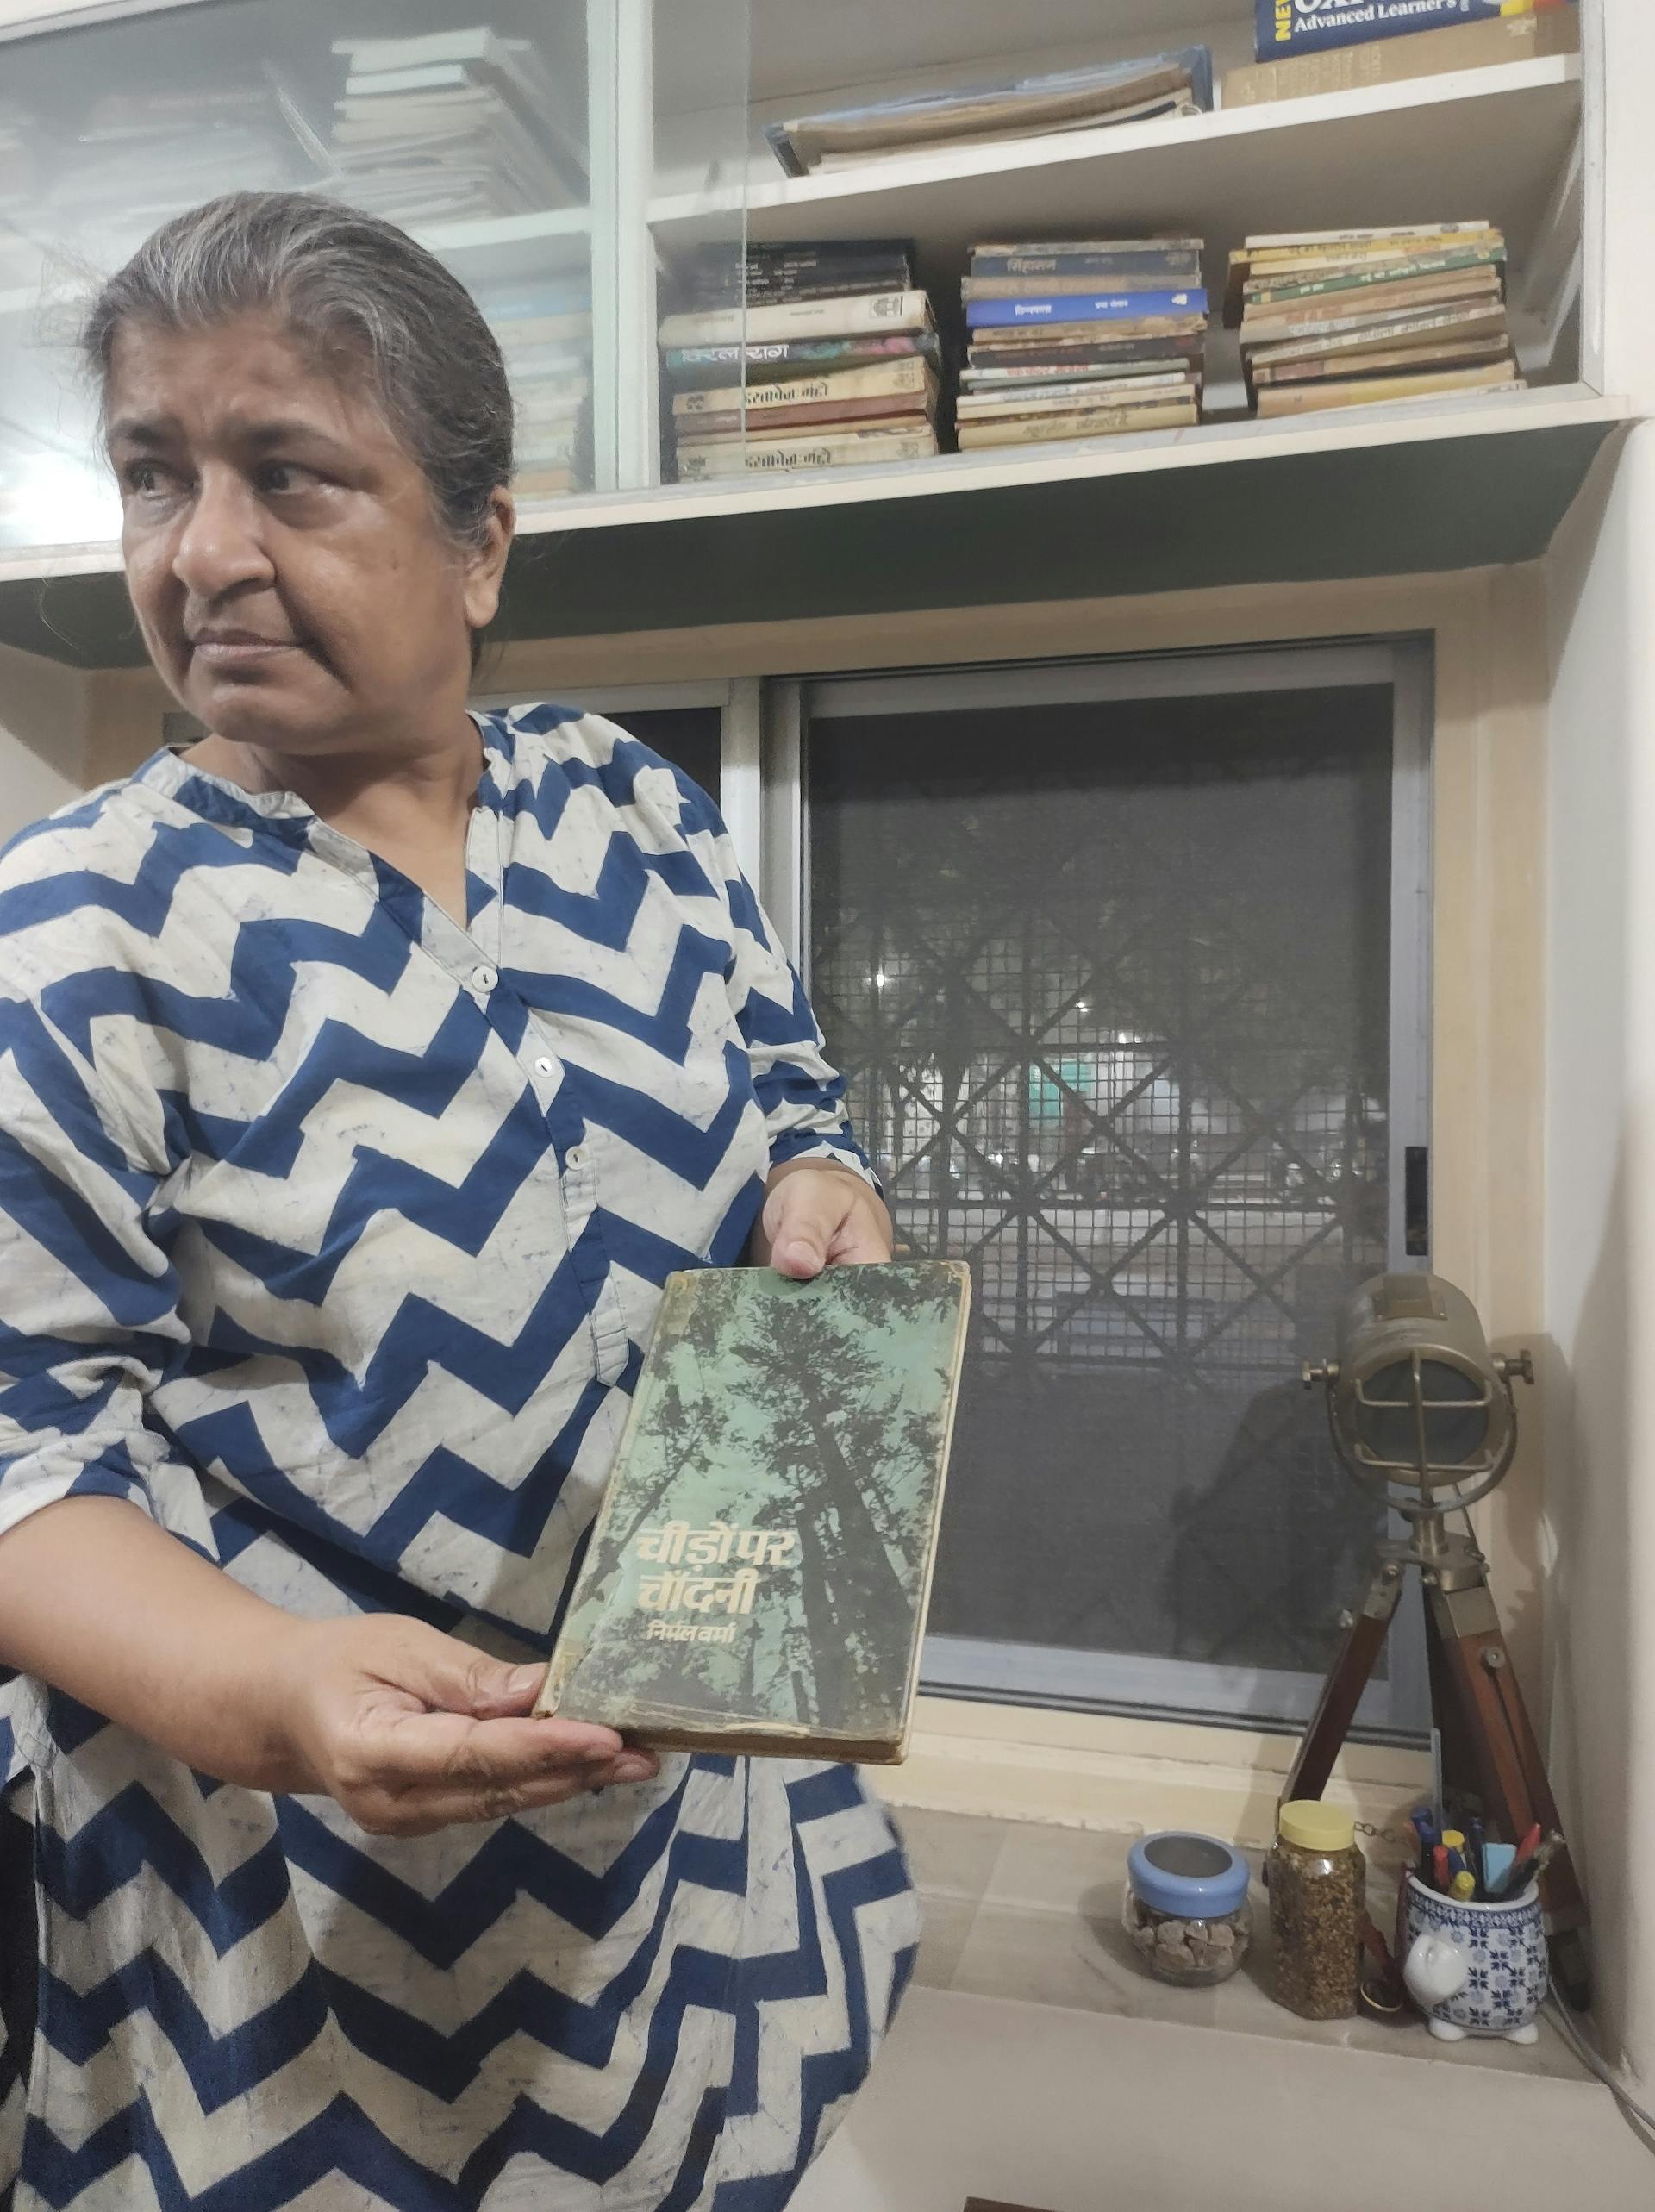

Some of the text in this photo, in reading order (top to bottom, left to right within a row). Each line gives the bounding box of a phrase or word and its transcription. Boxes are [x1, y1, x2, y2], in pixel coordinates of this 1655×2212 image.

[1275, 0, 1292, 41] NE
[1294, 4, 1375, 33] Advanced
[1377, 0, 1457, 19] Learners
[636, 1520, 798, 1572] चीड़ों पर
[646, 1619, 738, 1644] निर्मल वर्मा
